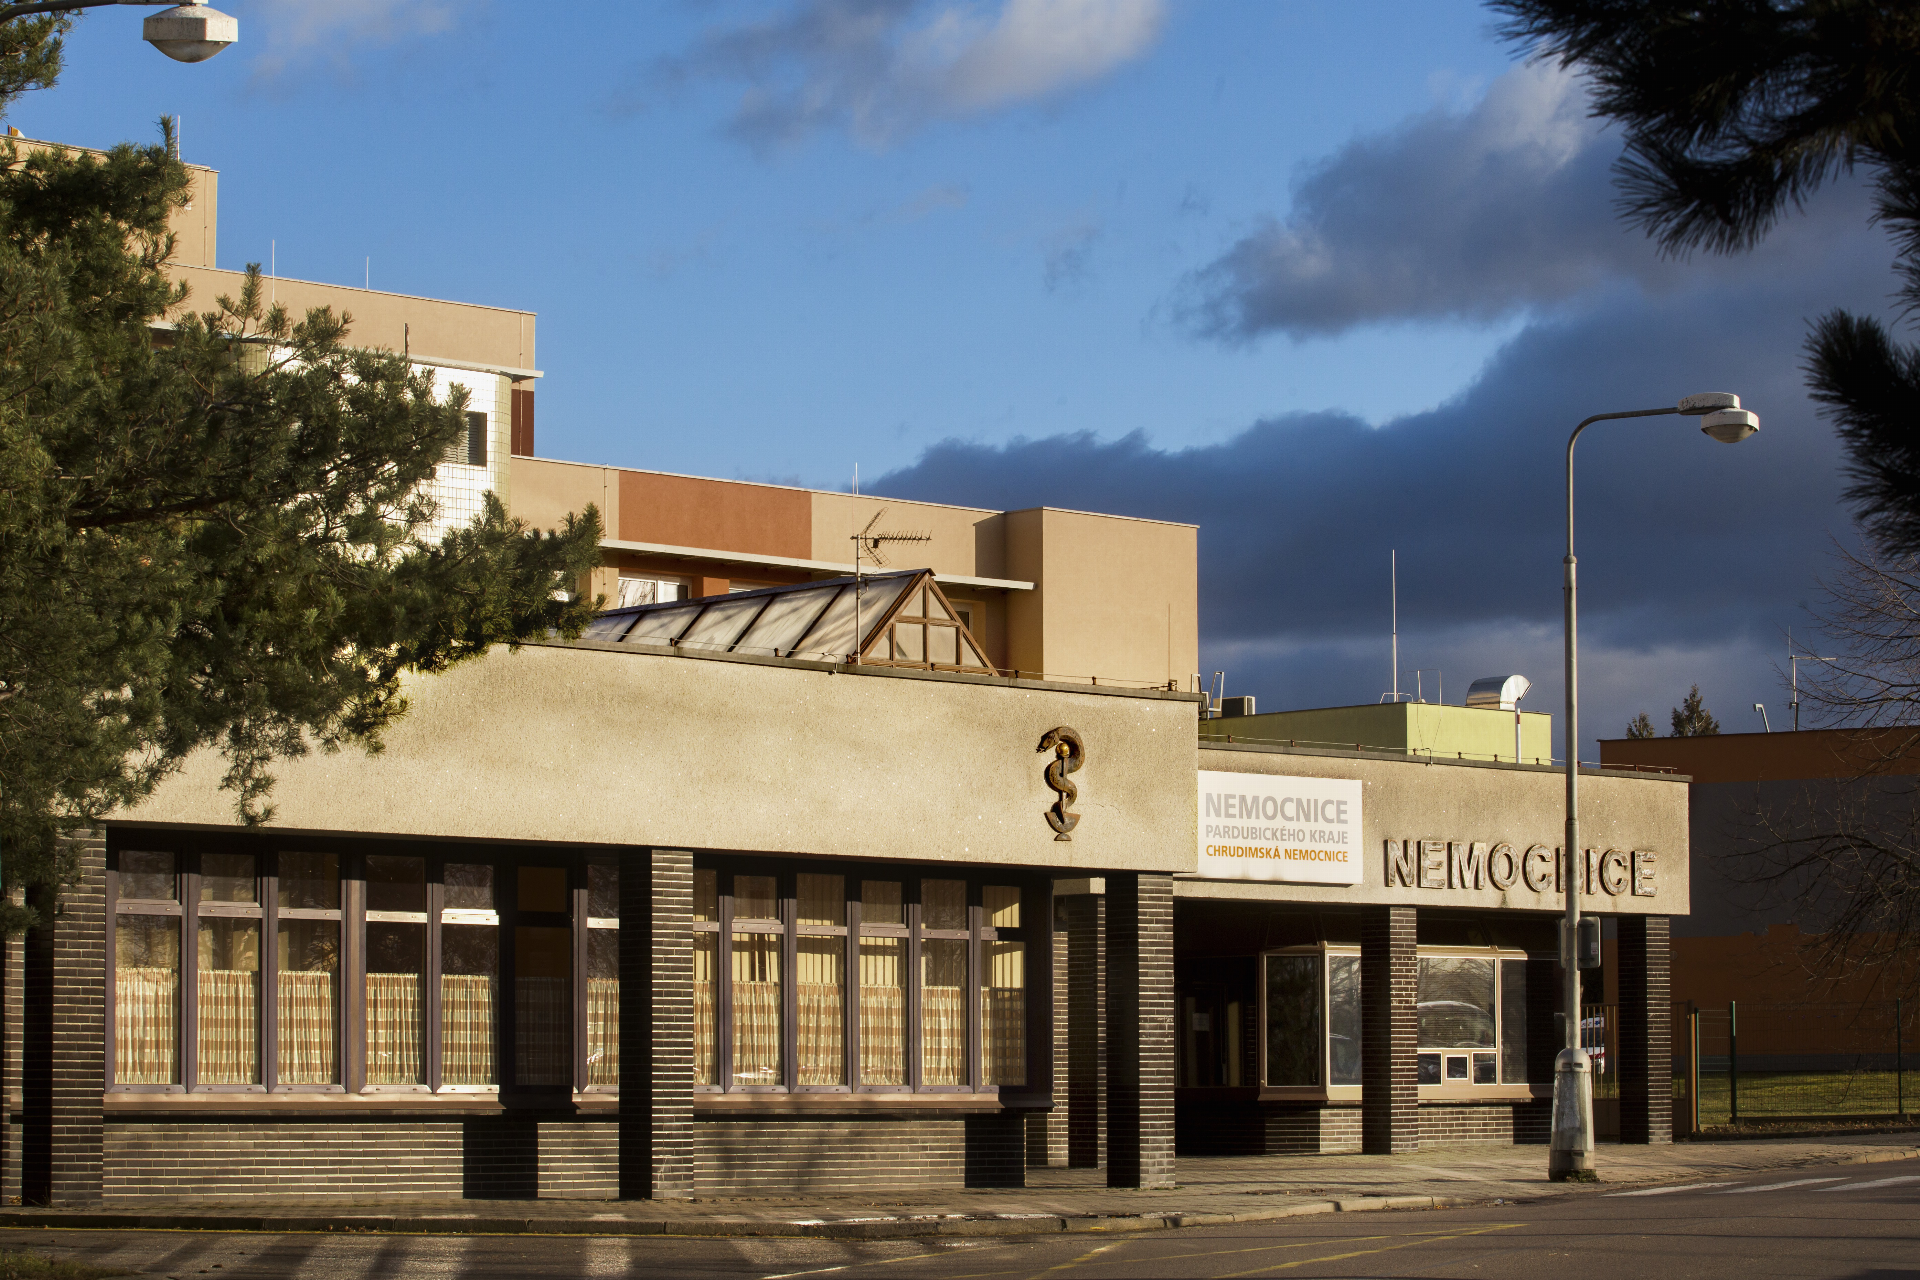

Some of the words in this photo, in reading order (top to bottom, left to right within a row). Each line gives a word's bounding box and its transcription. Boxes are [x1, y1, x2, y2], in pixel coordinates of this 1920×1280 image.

[1205, 792, 1348, 824] NEMOCNICE
[1205, 824, 1306, 843] PARDUBICKÉHO
[1309, 829, 1348, 845] KRAJE
[1206, 844, 1281, 860] CHRUDIMSKÁ
[1284, 848, 1348, 863] NEMOCNICE
